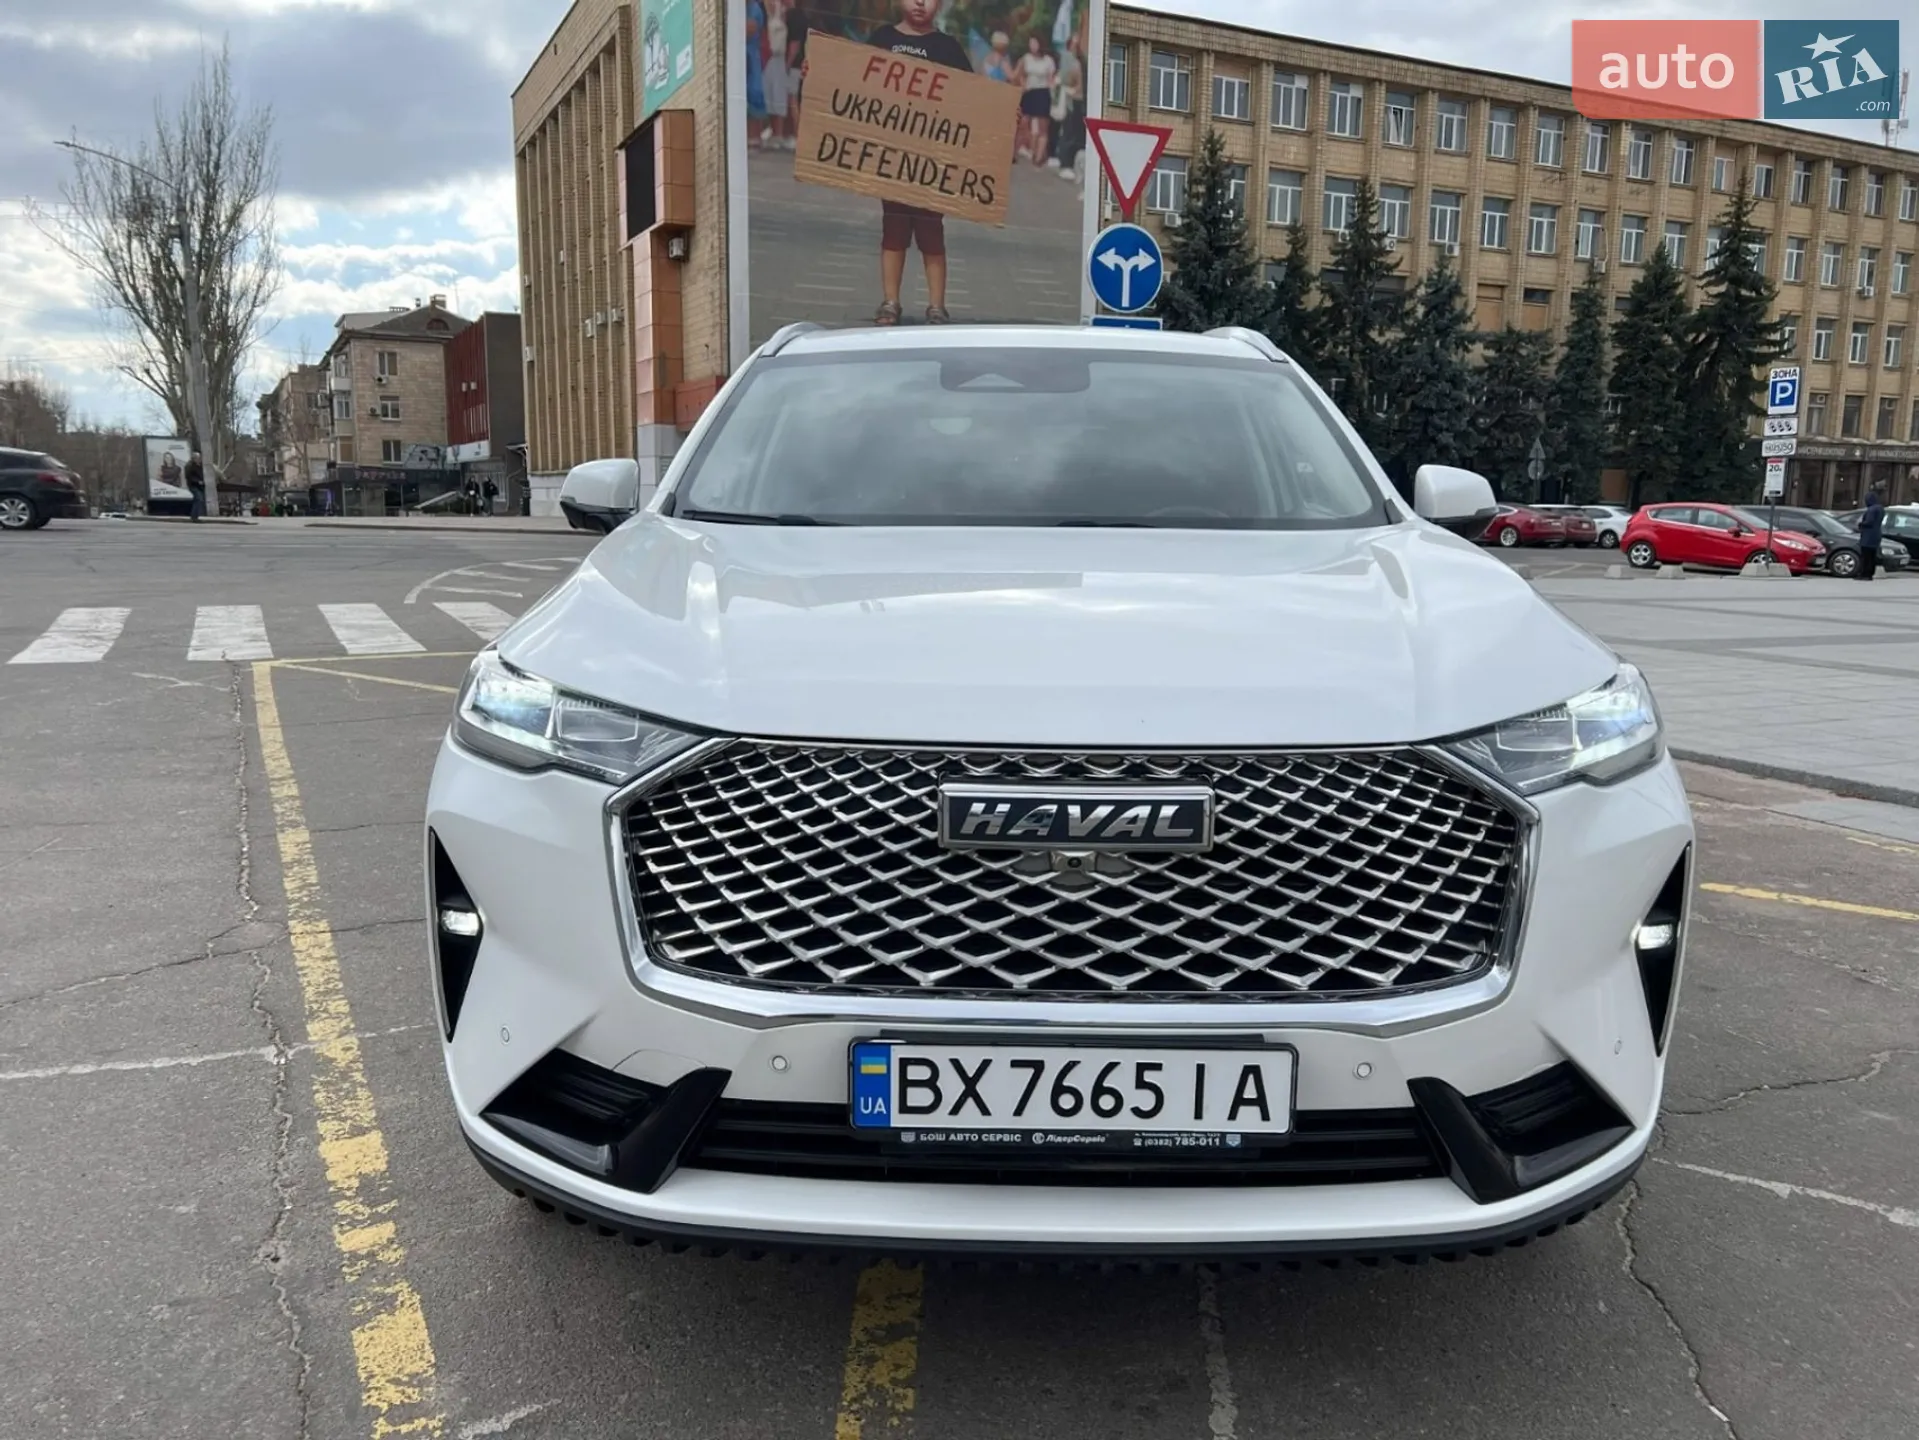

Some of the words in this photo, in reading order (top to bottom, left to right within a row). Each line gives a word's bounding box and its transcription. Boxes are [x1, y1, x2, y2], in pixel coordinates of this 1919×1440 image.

[862, 55, 949, 102] FREE
[817, 132, 996, 205] DEFENDERS
[1771, 369, 1798, 379] ЗОНА
[1775, 382, 1793, 404] P
[960, 802, 1194, 837] HAVAL
[898, 1057, 993, 1117] BX
[1010, 1060, 1165, 1119] 7665
[860, 1097, 888, 1115] UA
[920, 1133, 946, 1142] БОШ
[949, 1133, 979, 1142] АВТО
[981, 1133, 1022, 1143] СЕРВІС
